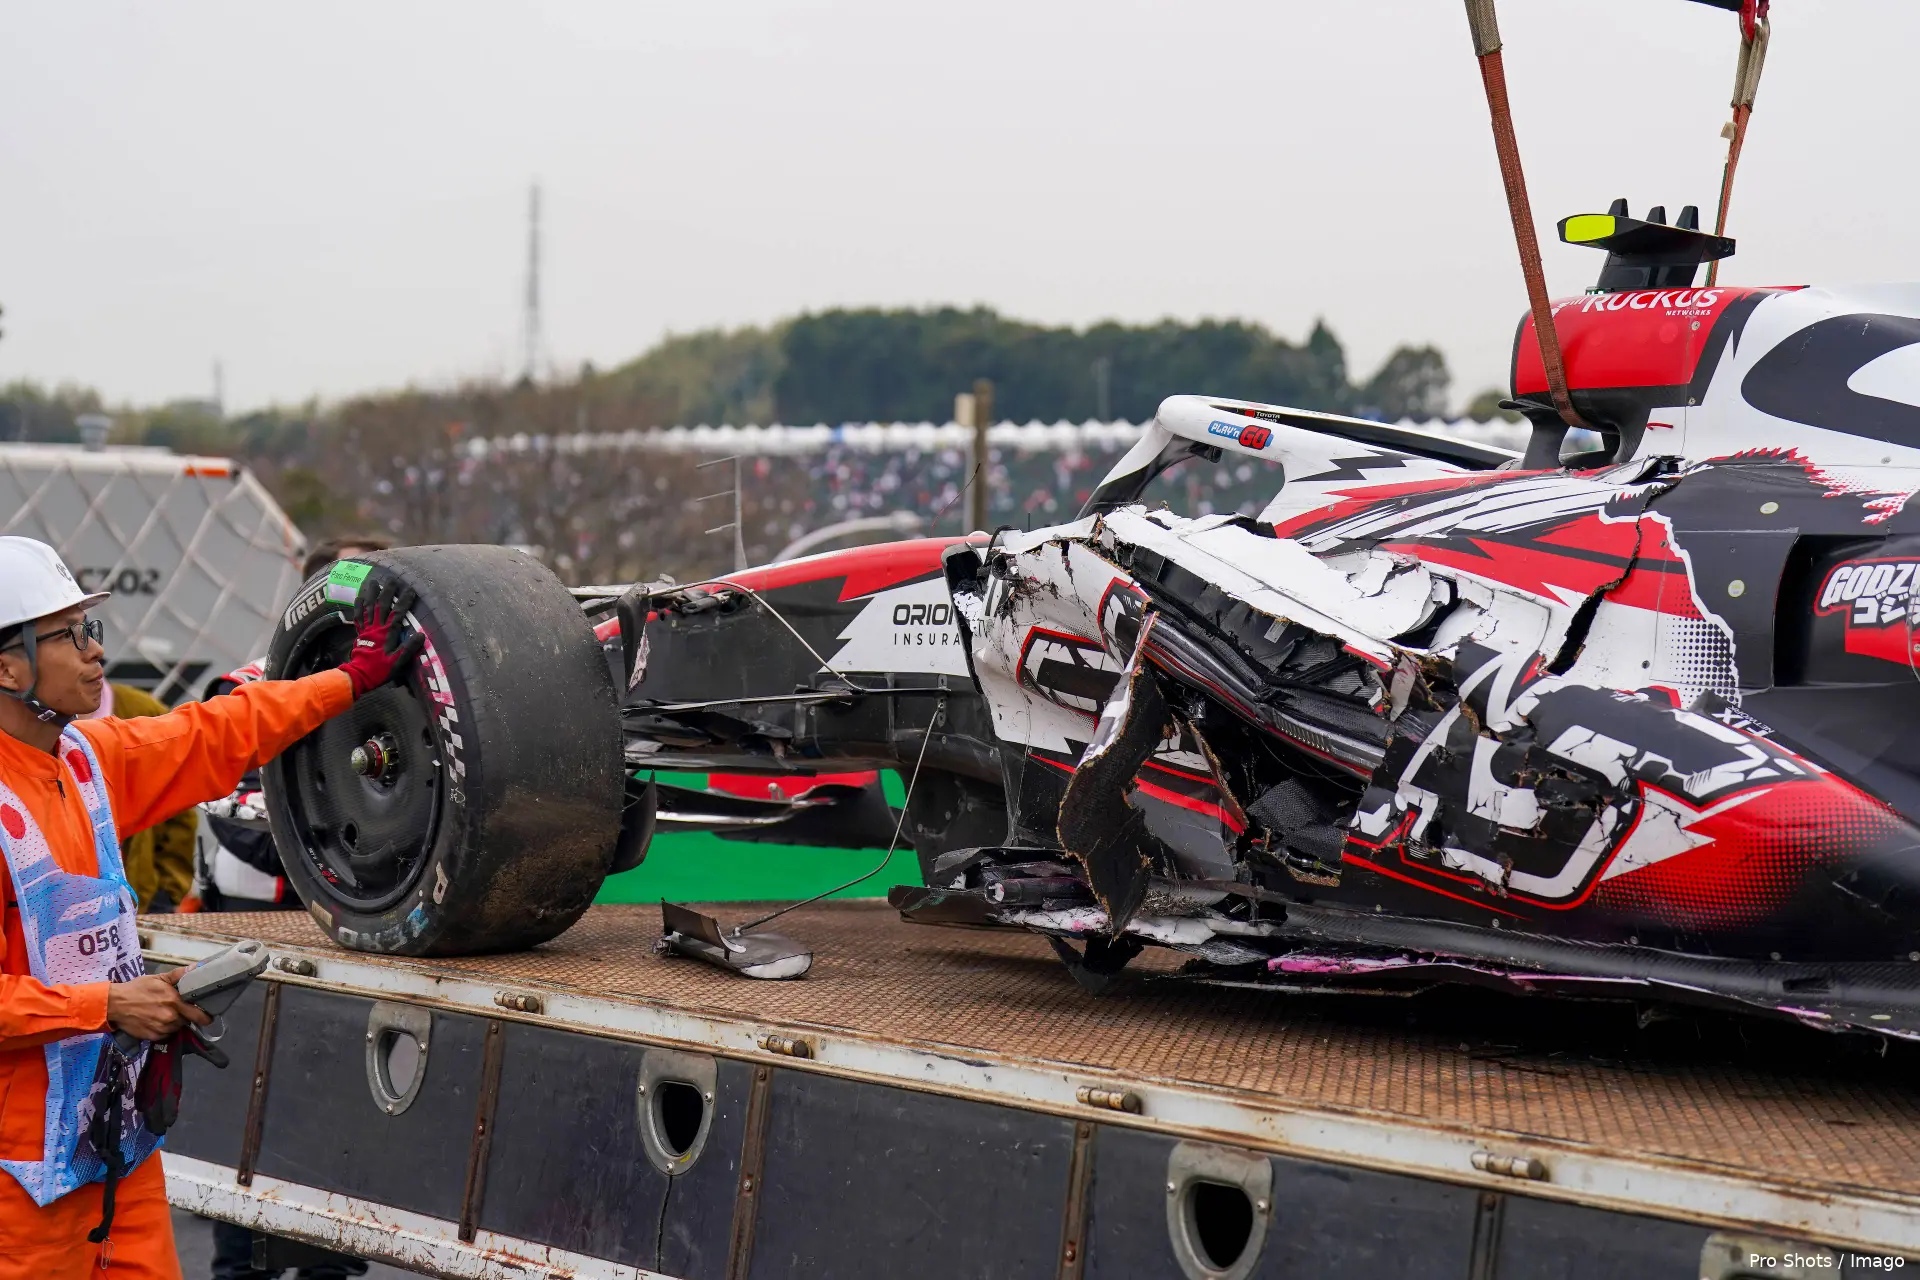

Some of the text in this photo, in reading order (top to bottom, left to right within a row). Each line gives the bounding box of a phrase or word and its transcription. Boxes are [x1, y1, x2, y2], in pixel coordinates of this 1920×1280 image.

[1582, 289, 1724, 313] RUCKUS
[1256, 411, 1281, 419] TOYOTA
[1239, 425, 1271, 450] GO
[1821, 563, 1920, 608] GODZI
[1711, 707, 1771, 737] FIX
